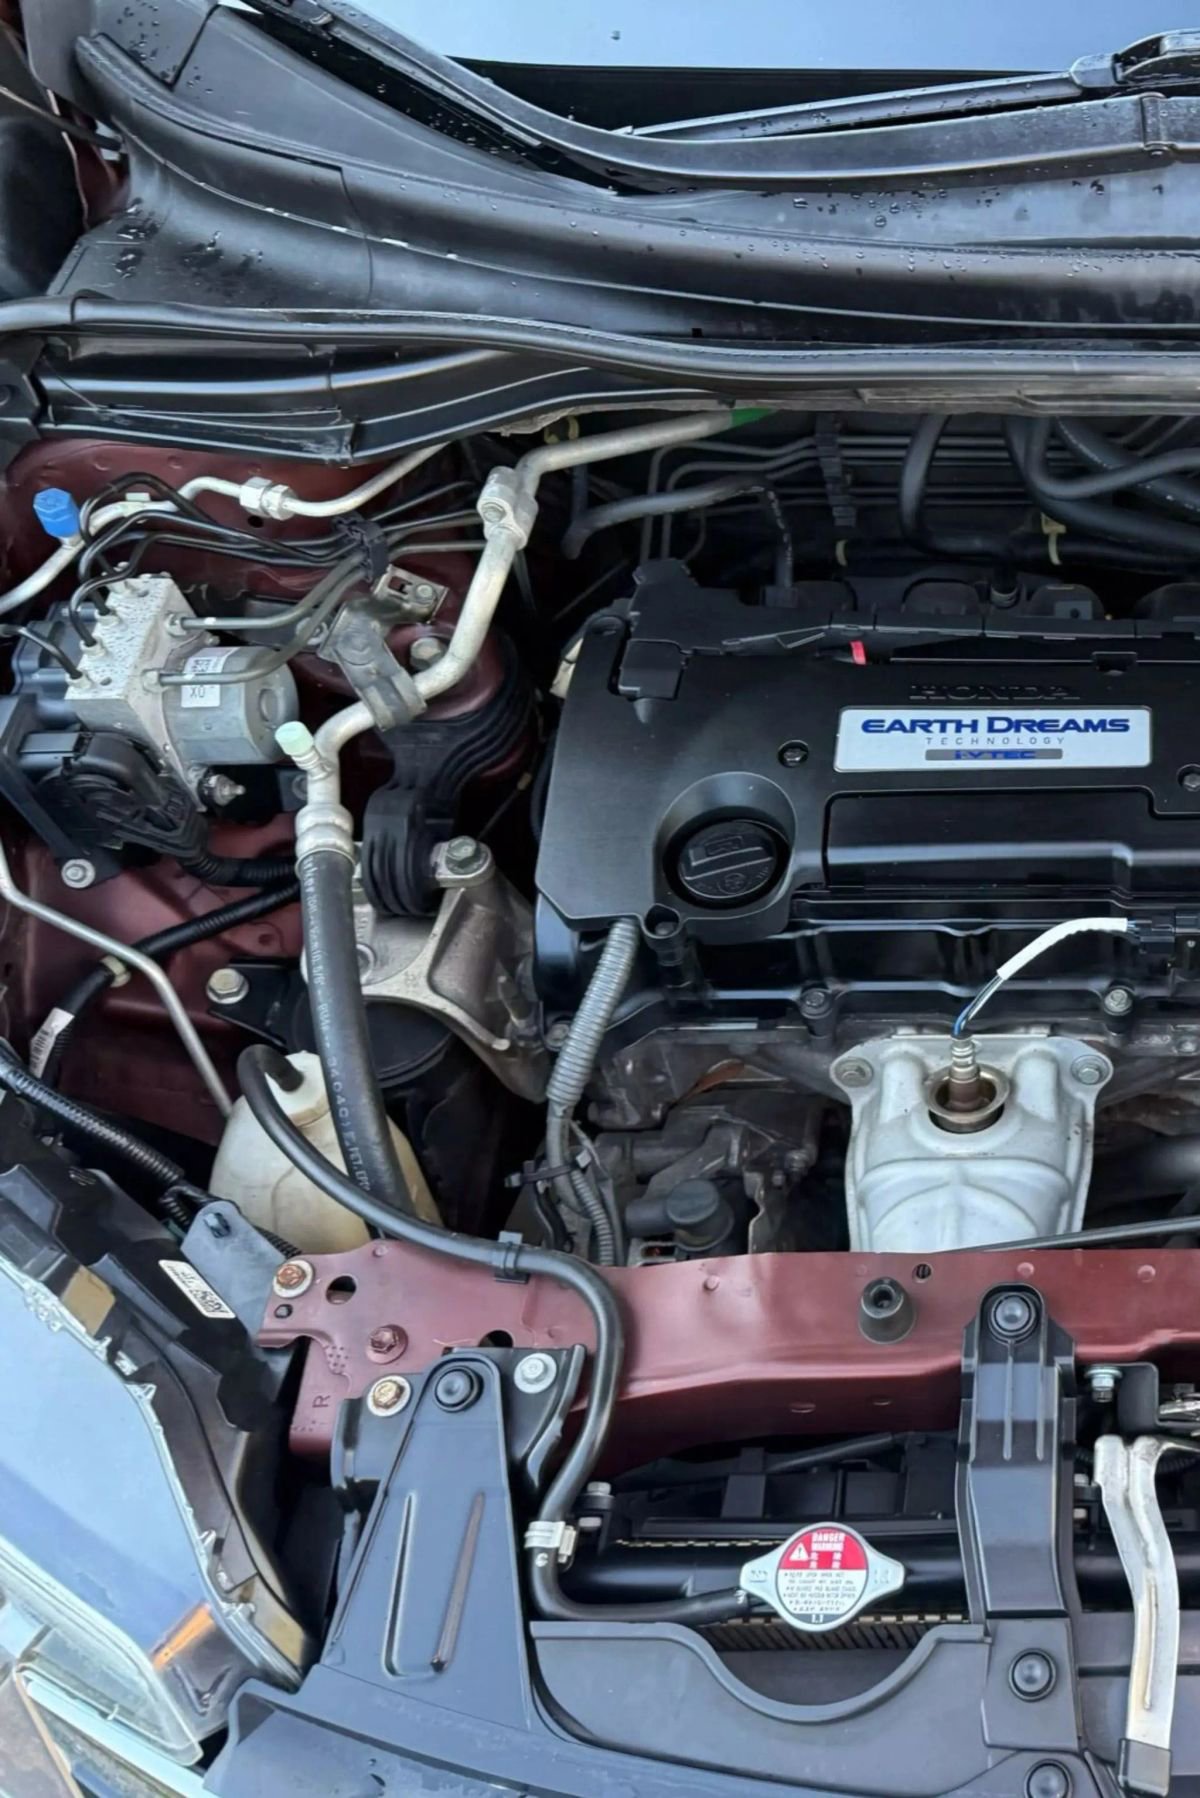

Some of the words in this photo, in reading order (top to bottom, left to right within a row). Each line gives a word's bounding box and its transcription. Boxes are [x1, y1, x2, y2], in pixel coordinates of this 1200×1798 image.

[909, 684, 1081, 701] HONDA
[861, 718, 978, 734] EARTH
[986, 716, 1130, 734] DREAMS
[925, 736, 1066, 746] TECHNOLOGY
[954, 749, 1037, 760] i-VTEC
